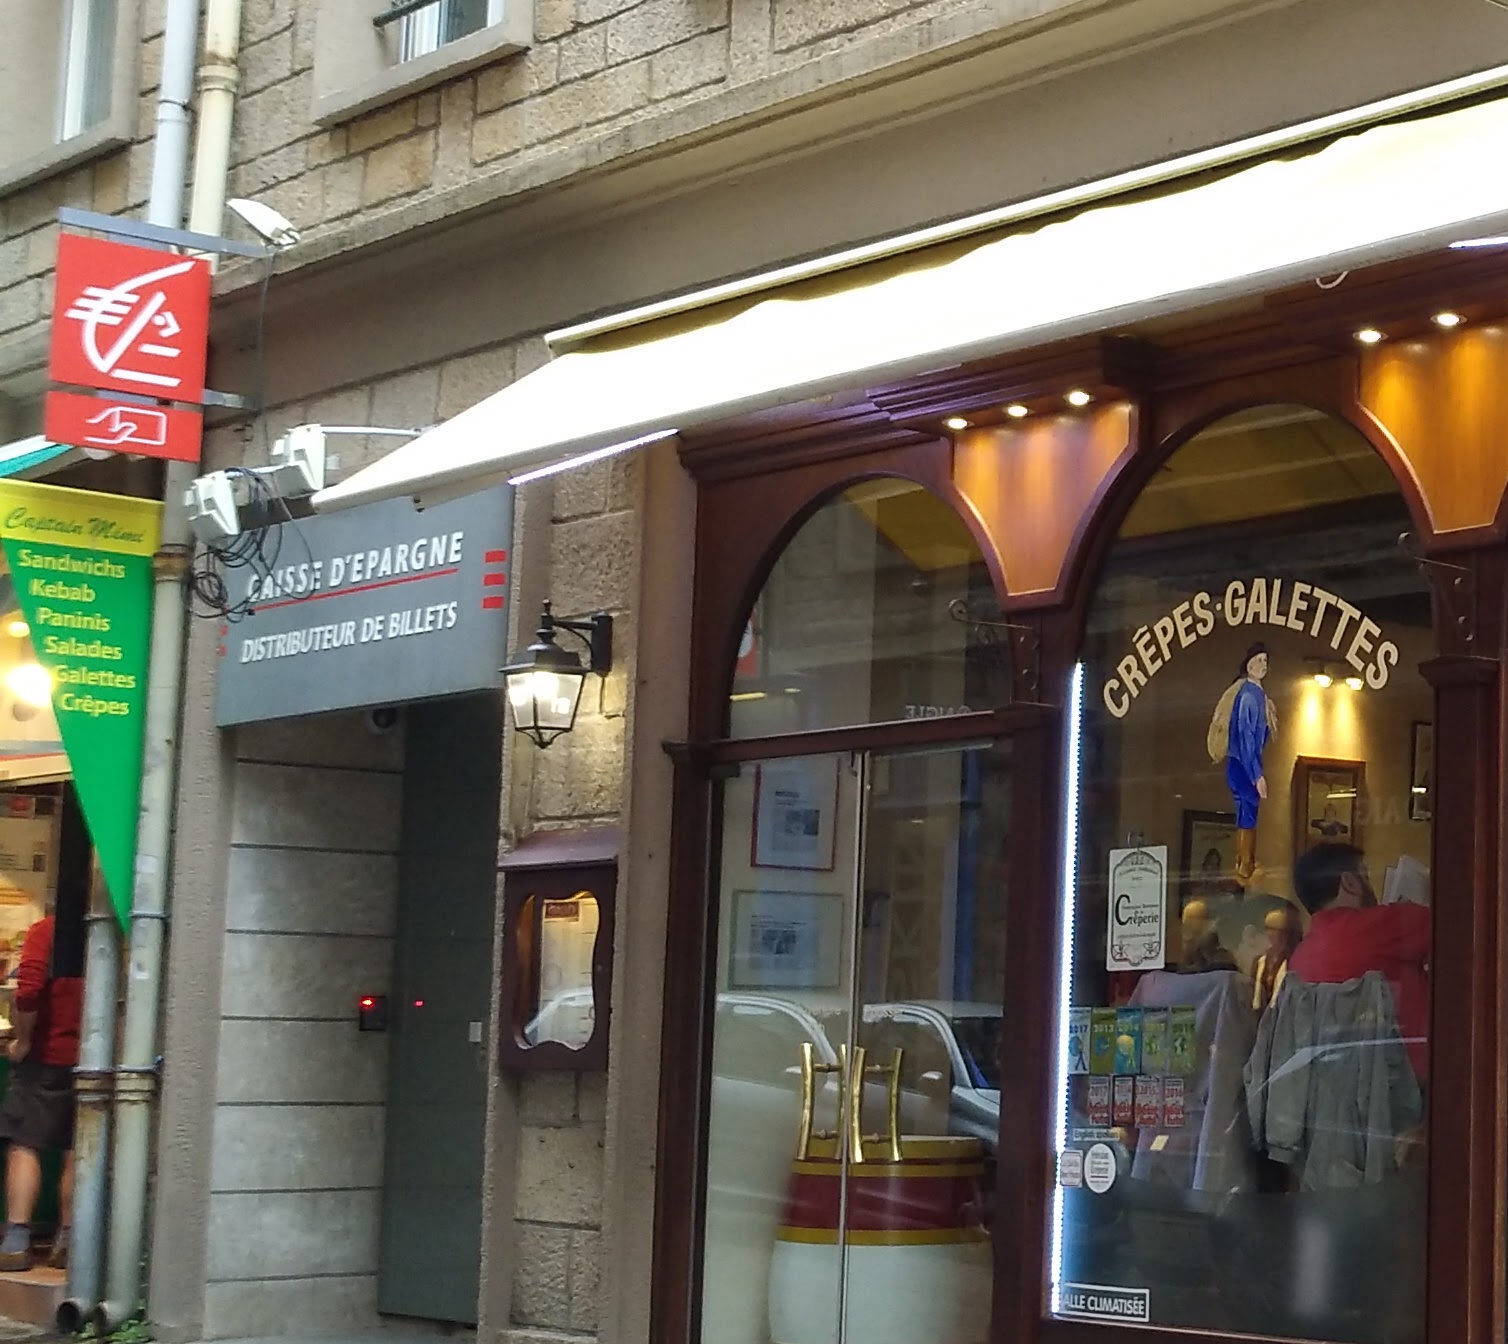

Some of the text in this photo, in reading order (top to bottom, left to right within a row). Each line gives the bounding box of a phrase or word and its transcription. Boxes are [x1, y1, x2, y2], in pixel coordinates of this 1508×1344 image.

[17, 548, 126, 578] Sandwichs
[329, 531, 464, 587] D'EPARGNE
[29, 578, 96, 602] Kebab
[37, 607, 111, 631] Paninis
[240, 601, 458, 664] DISTRIBUTEUR DE BILLETS
[44, 636, 123, 660] Salades
[55, 664, 136, 689] Galettes
[60, 693, 130, 717] Crêpes
[1087, 1296, 1145, 1316] CLIMATISÉE
